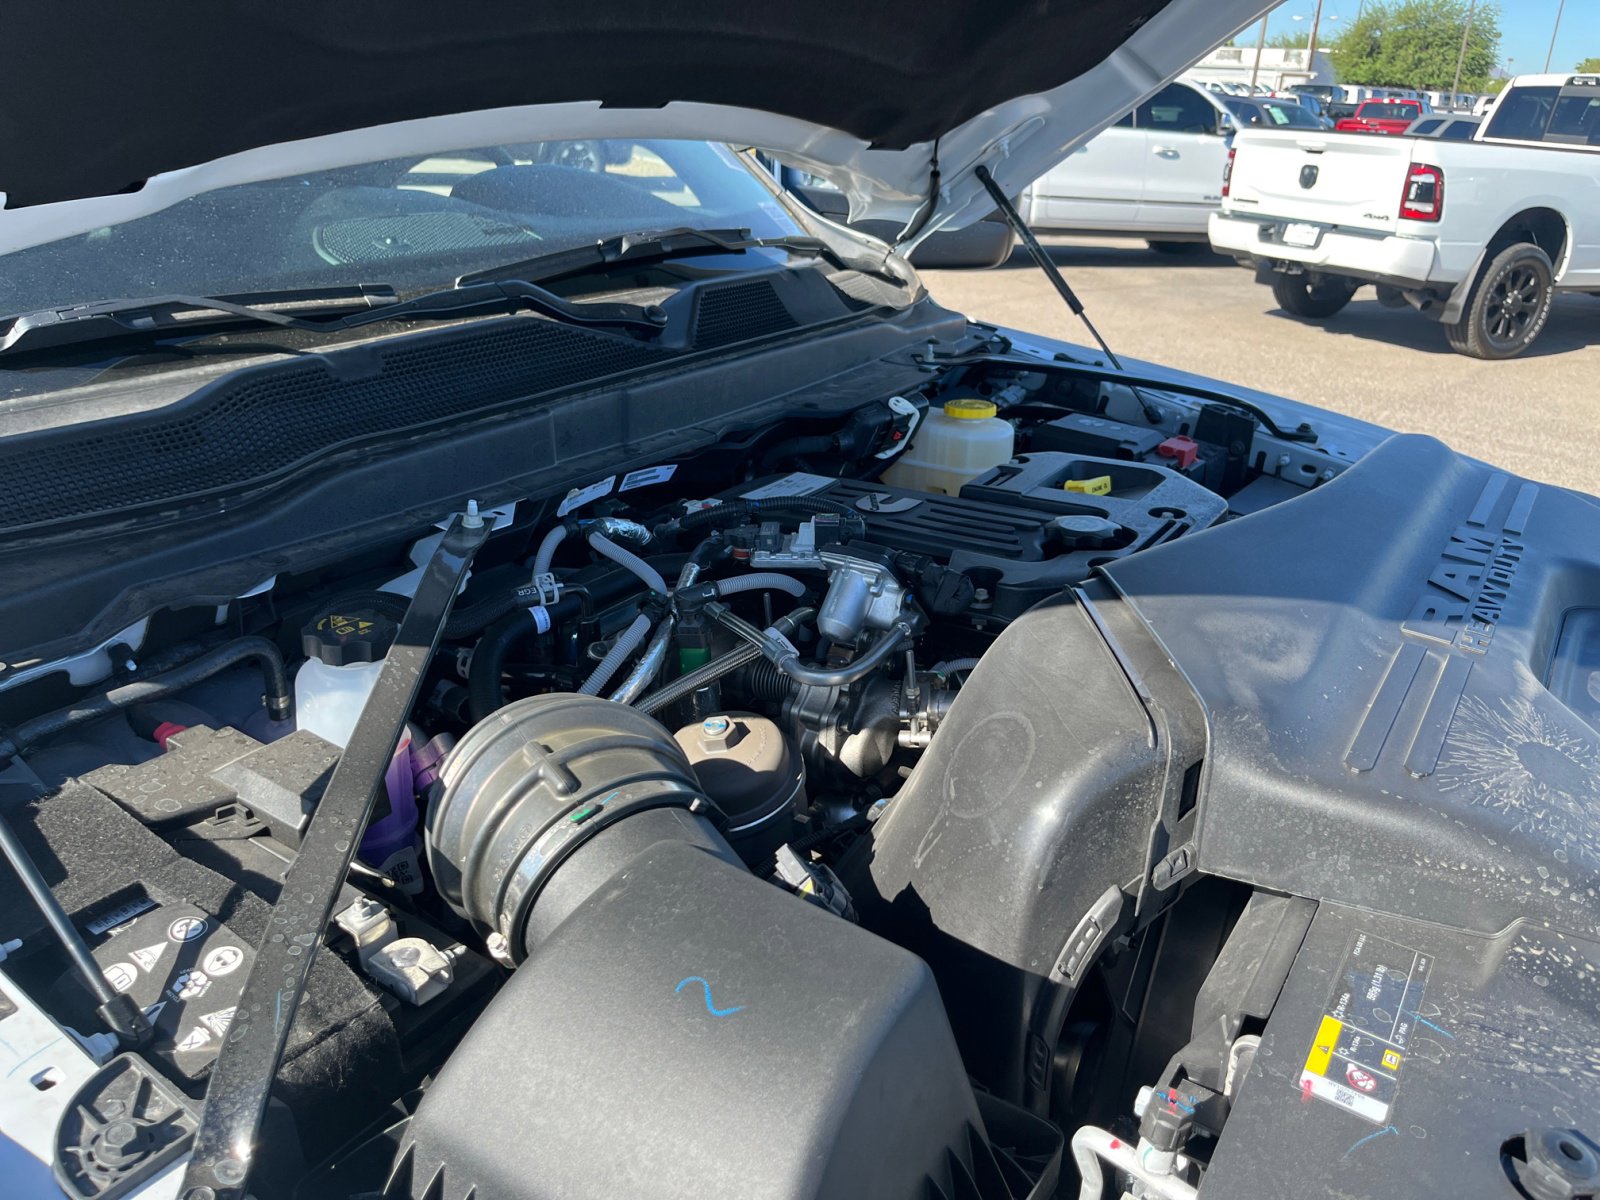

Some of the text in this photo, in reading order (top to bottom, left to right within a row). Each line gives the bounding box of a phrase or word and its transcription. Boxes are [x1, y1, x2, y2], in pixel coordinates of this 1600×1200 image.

[517, 585, 537, 597] EGR
[1400, 525, 1498, 643] RAM
[1338, 992, 1350, 1011] R-134a
[1398, 1022, 1408, 1035] PAG
